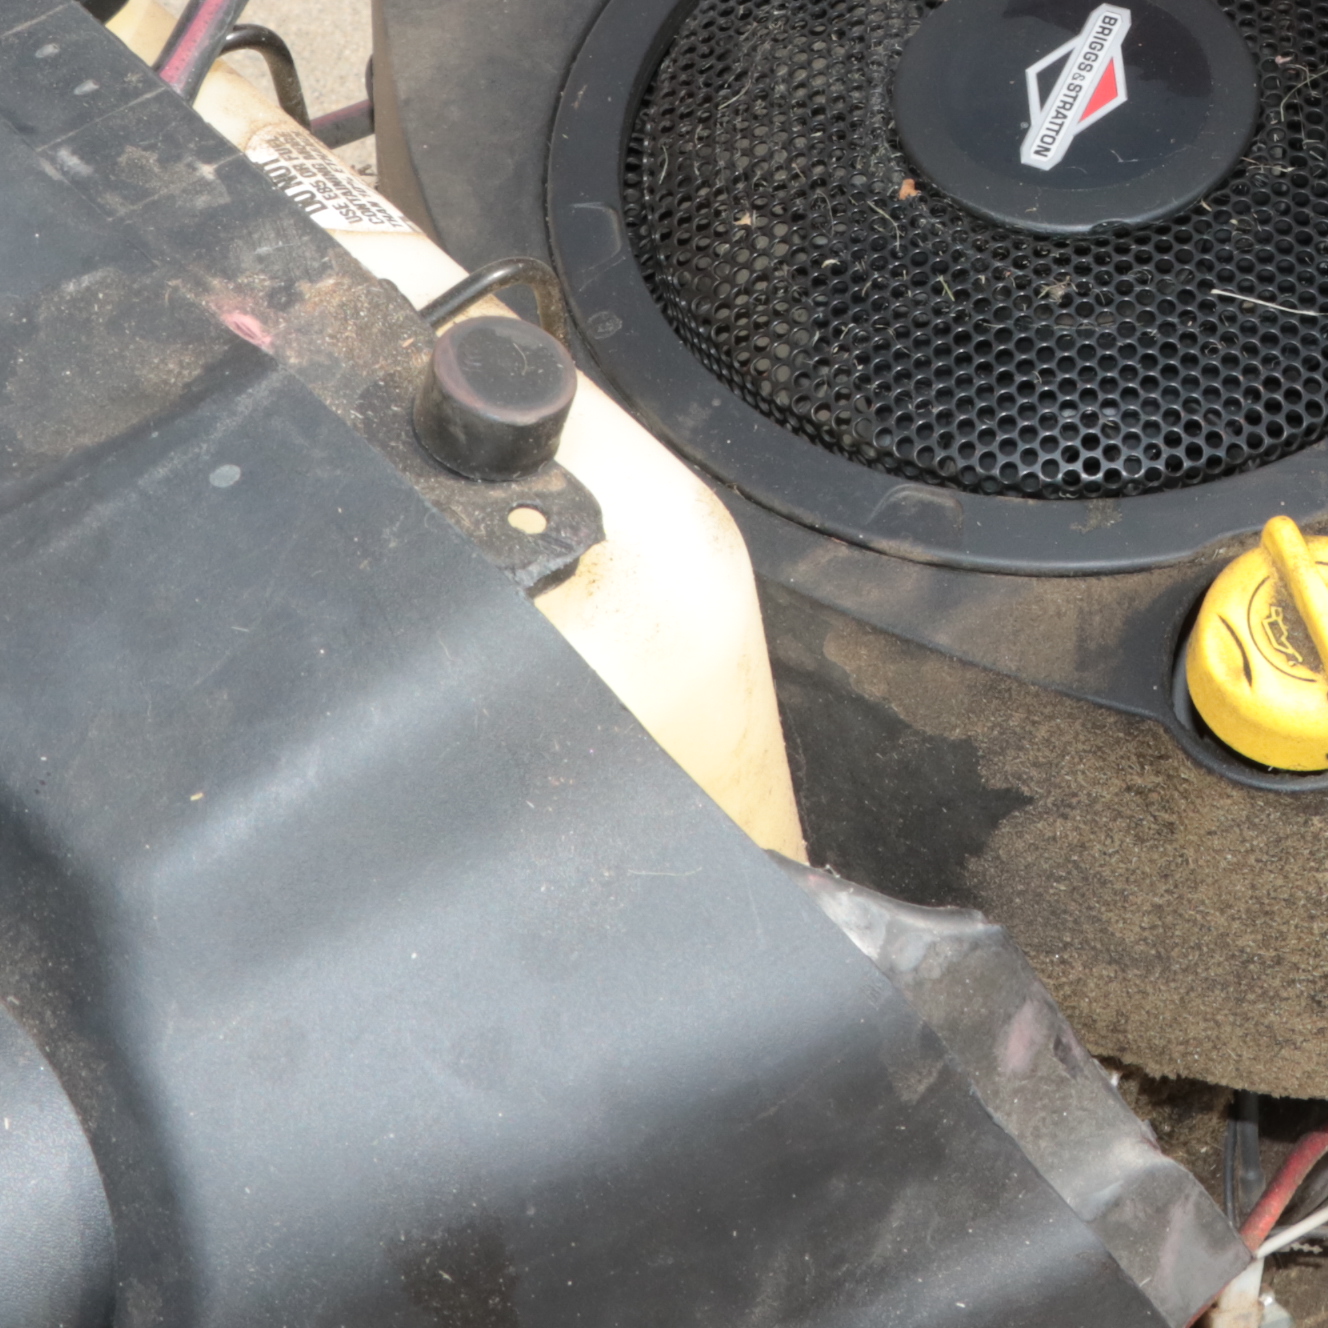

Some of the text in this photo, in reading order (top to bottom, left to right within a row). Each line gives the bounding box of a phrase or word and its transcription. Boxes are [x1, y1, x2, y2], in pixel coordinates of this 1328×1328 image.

[291, 163, 317, 179] OR
[310, 181, 339, 201] E85
[313, 163, 385, 225] CONTAINING
[332, 201, 364, 224] USE
[367, 200, 405, 229] THAN
